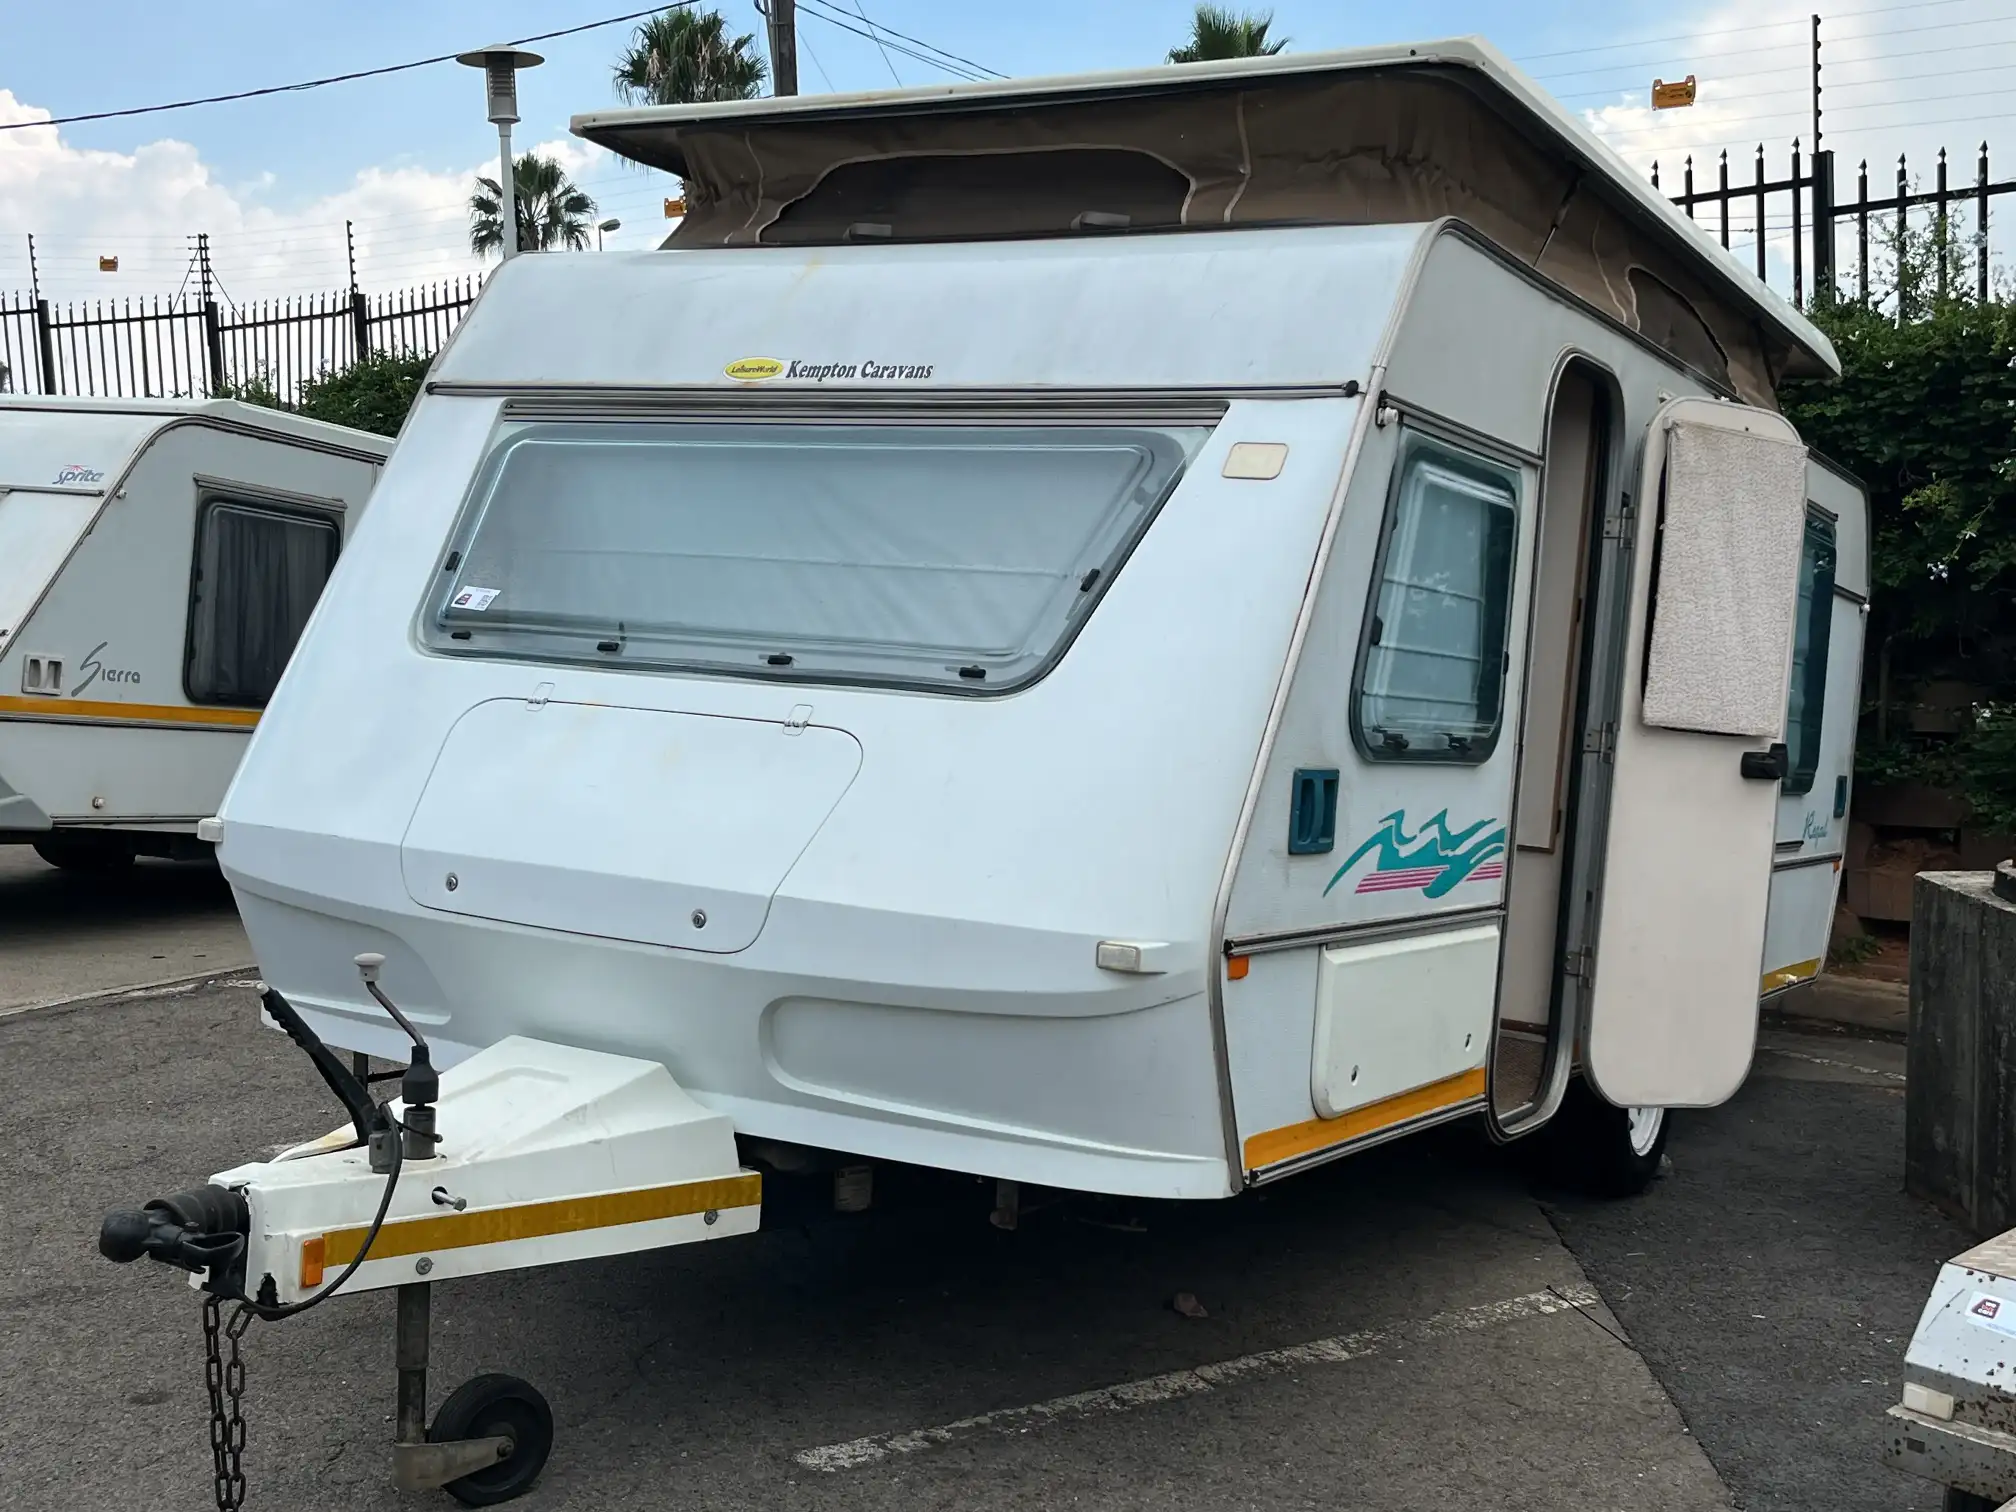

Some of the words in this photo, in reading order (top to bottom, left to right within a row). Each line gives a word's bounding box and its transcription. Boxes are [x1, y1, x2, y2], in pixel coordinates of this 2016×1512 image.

[786, 360, 857, 382] Kempton
[860, 360, 933, 379] Caravans
[71, 641, 141, 697] Sierra
